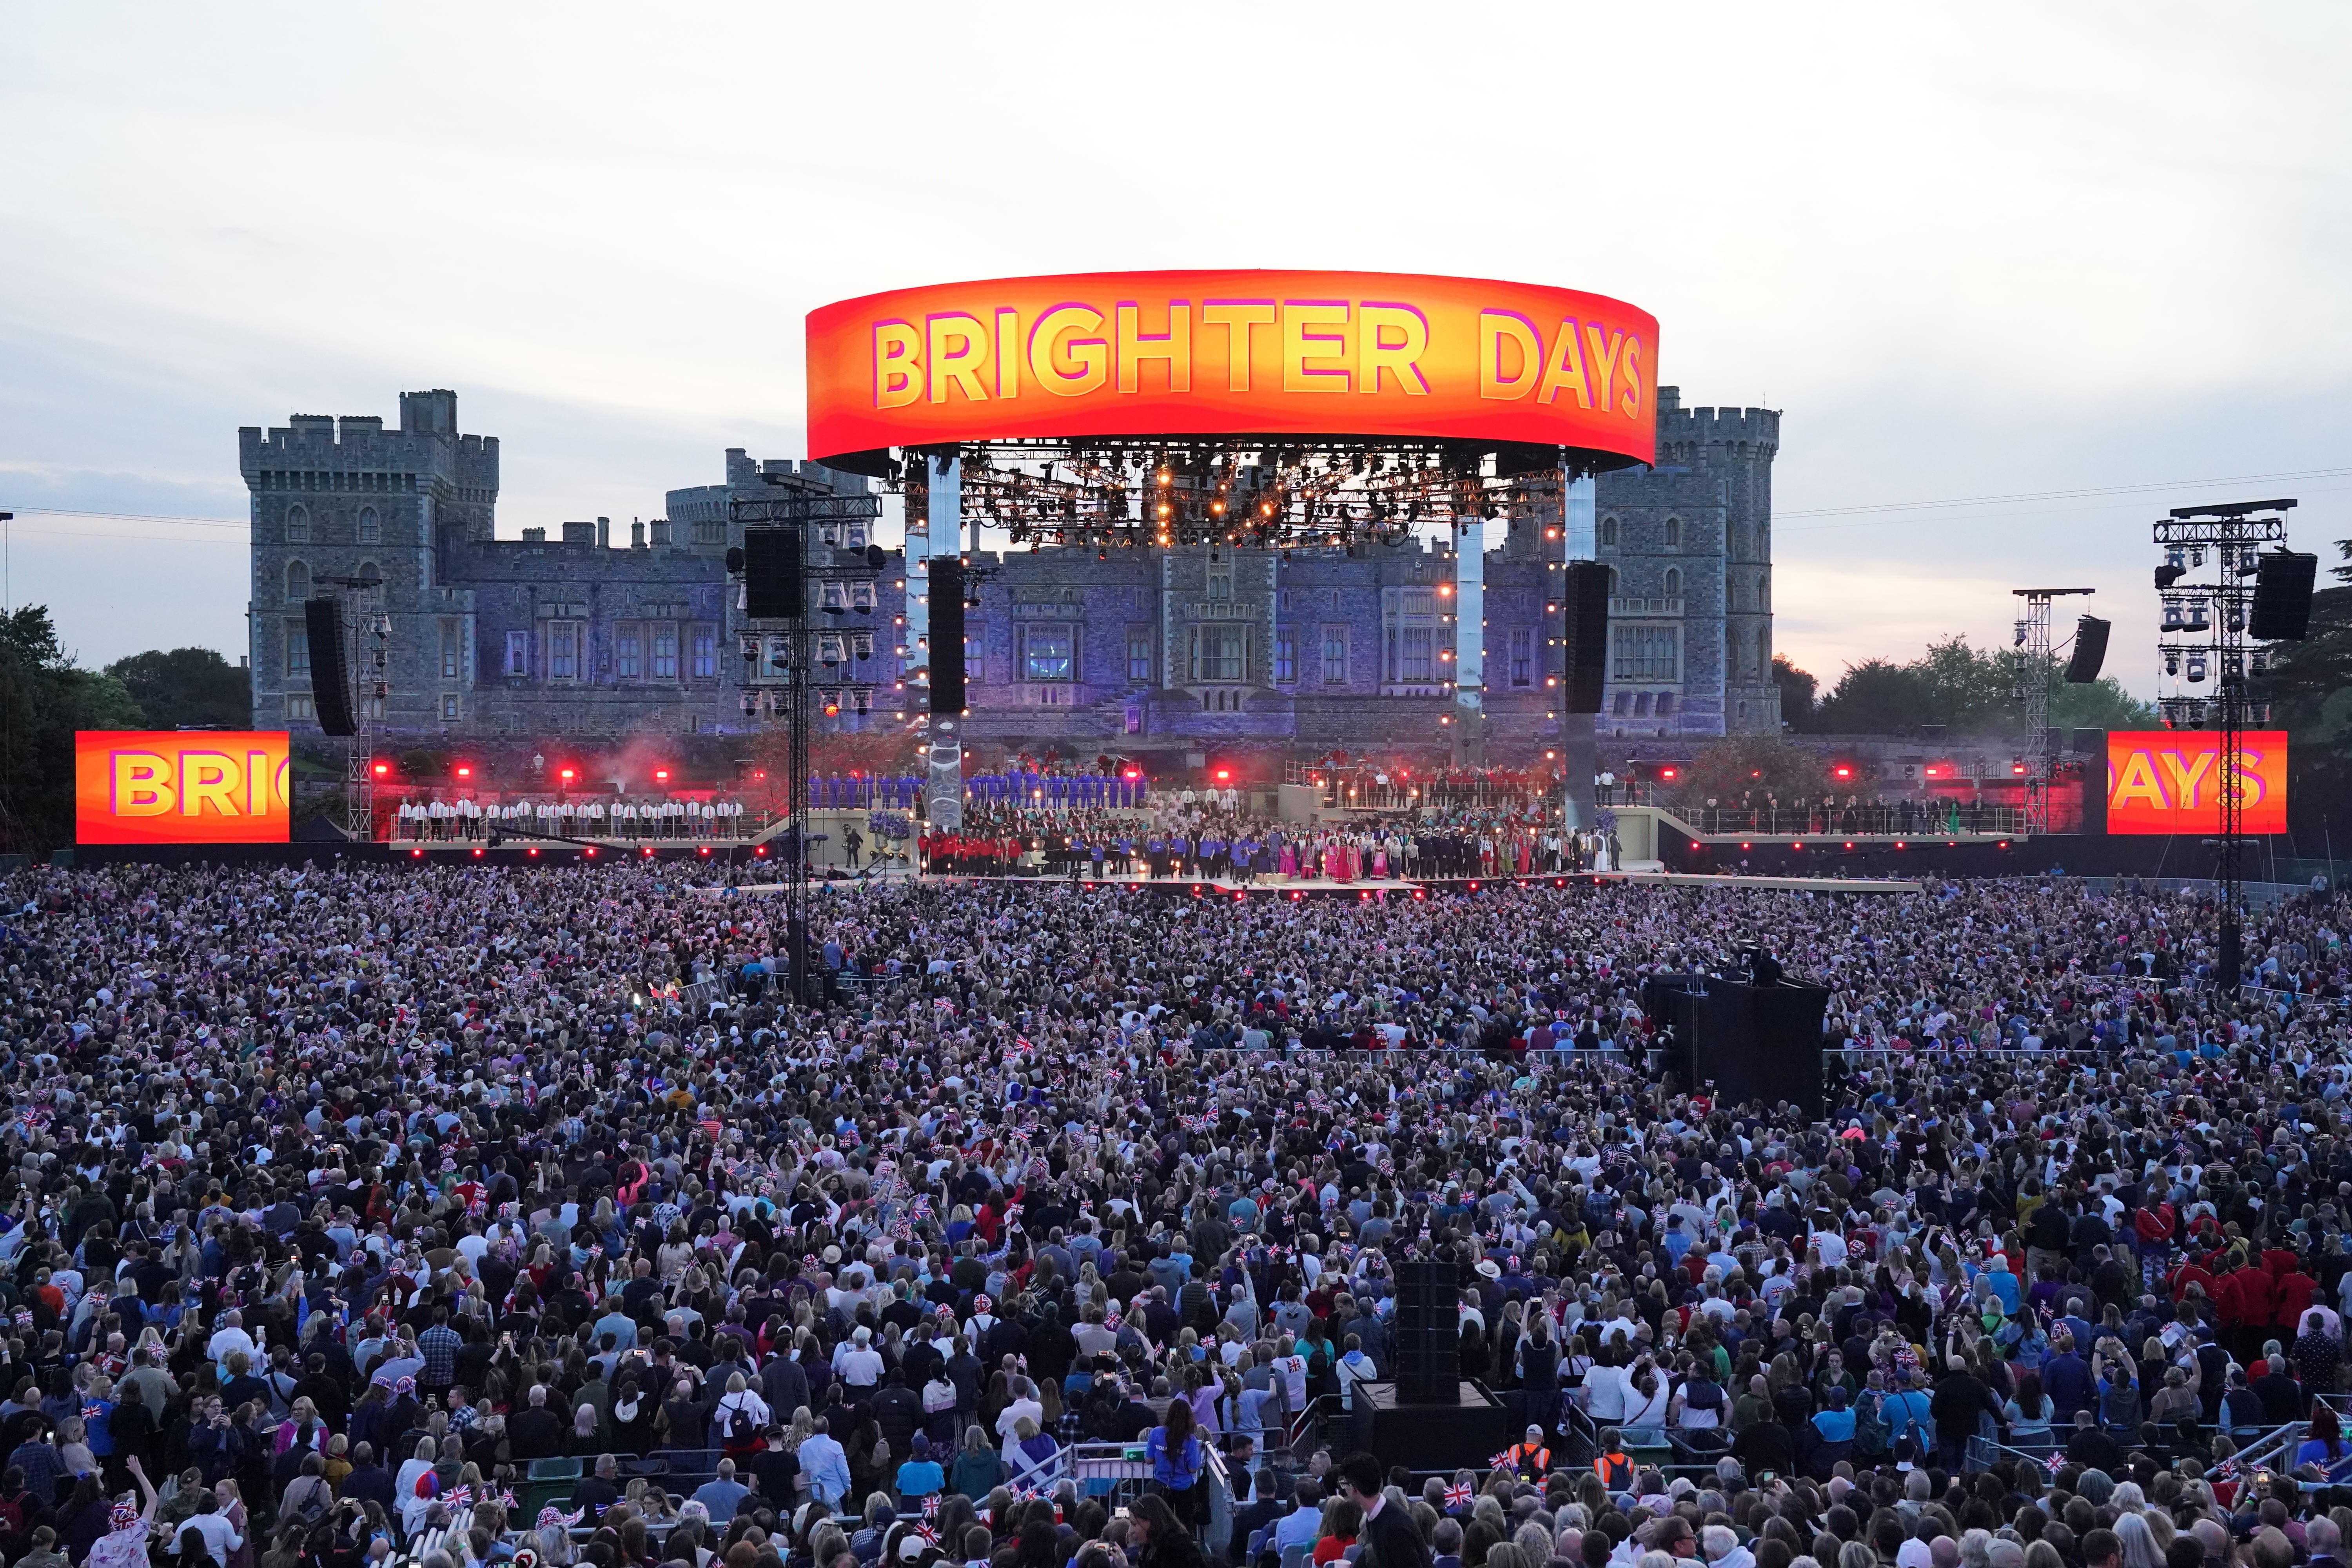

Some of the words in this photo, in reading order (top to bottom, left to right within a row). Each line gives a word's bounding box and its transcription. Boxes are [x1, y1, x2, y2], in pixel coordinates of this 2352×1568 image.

[872, 299, 1430, 409] BRIGHTER
[1480, 308, 1642, 419] DAYS
[109, 750, 289, 816] BRI
[2108, 748, 2266, 809] AYS
